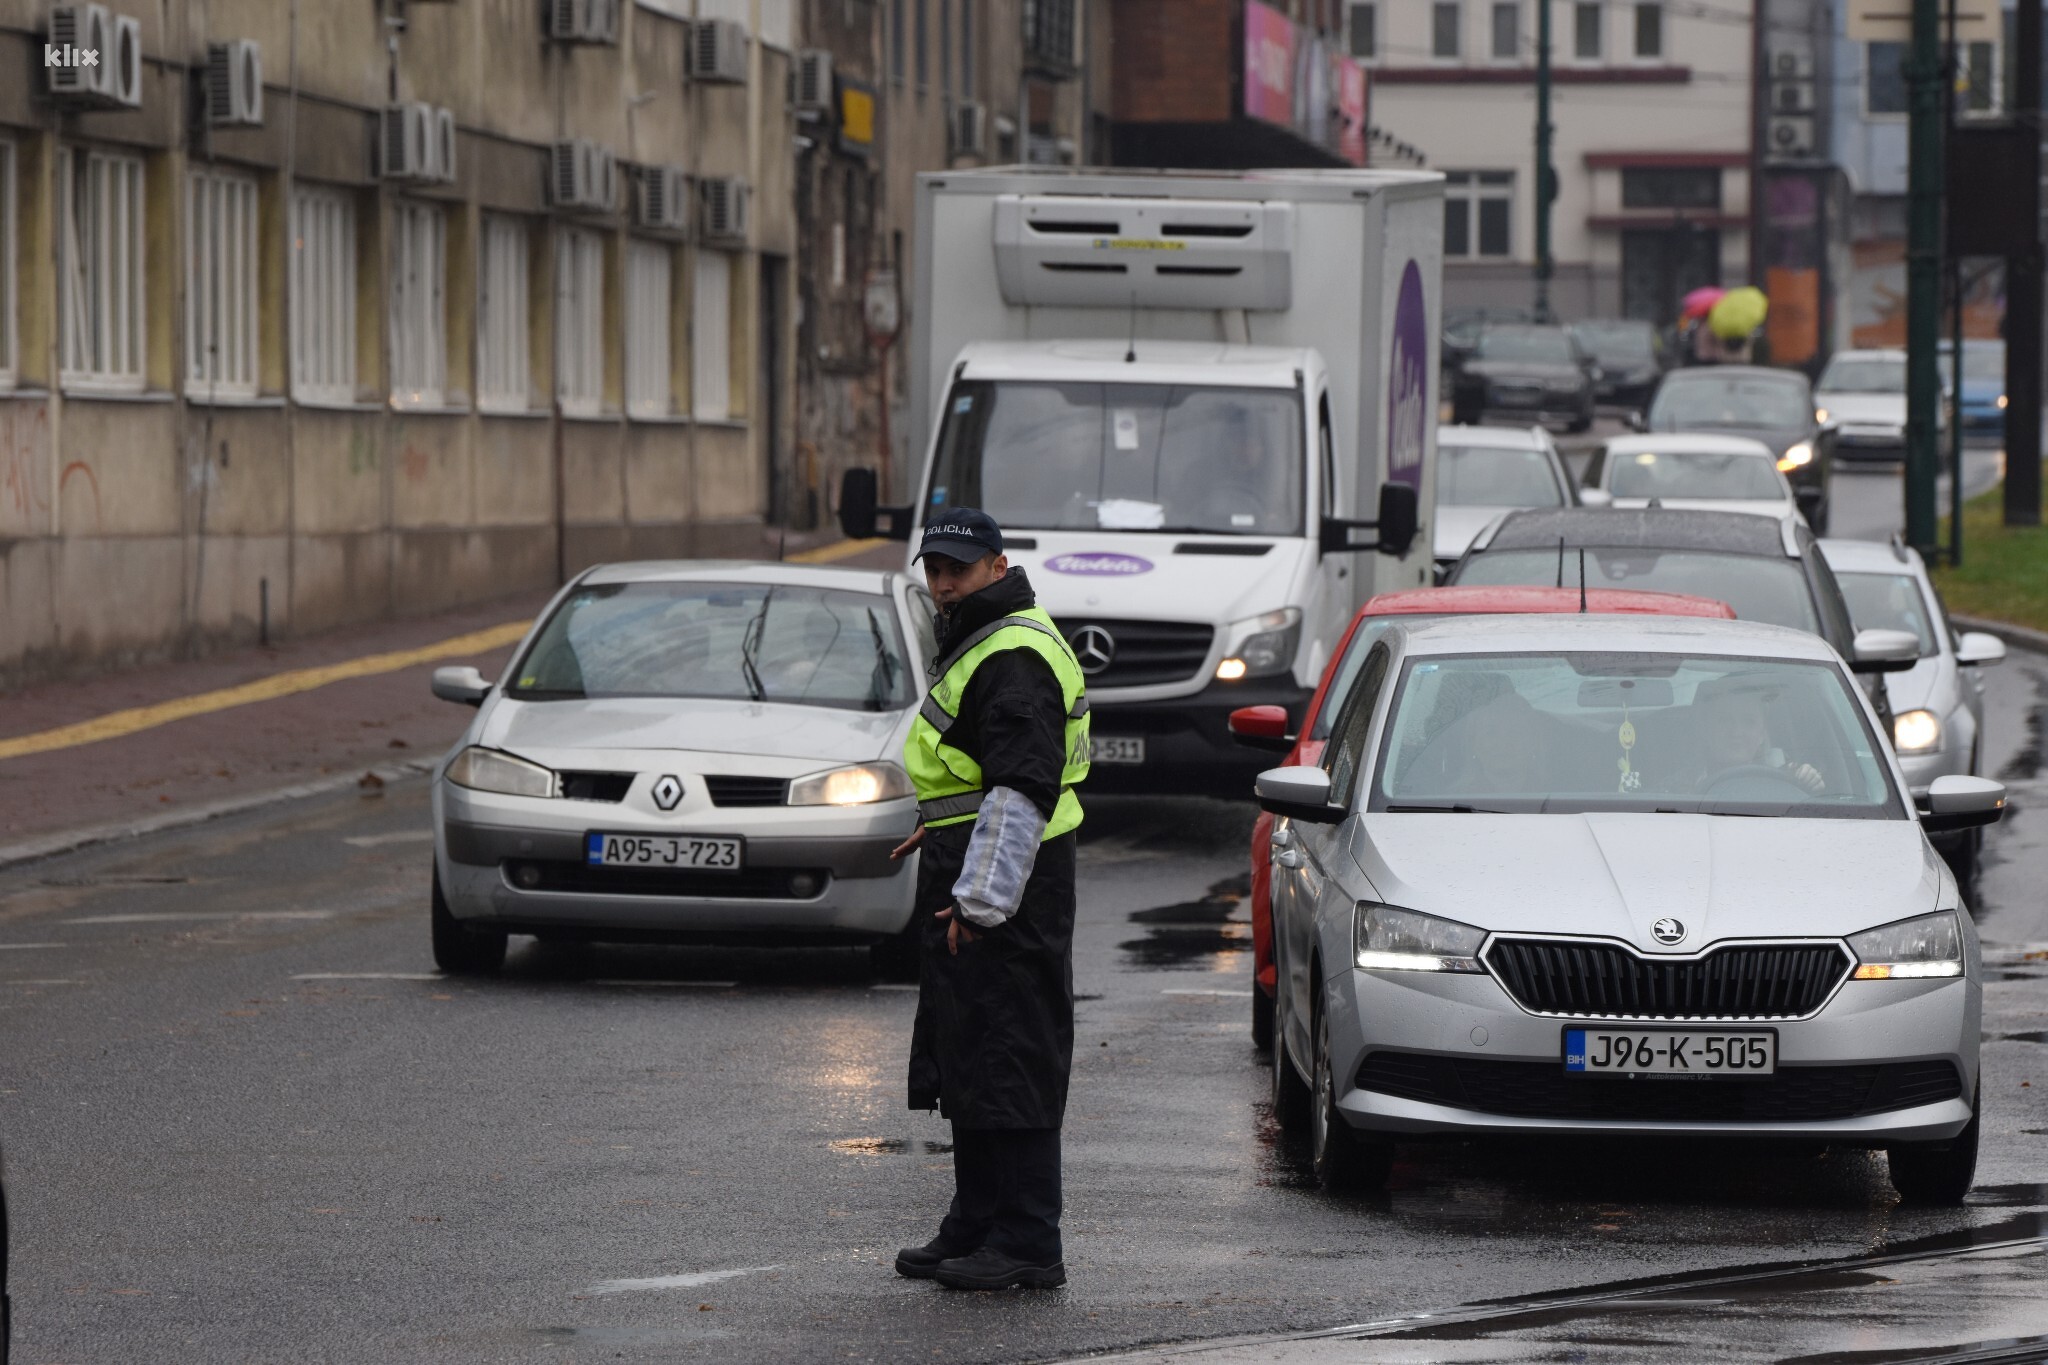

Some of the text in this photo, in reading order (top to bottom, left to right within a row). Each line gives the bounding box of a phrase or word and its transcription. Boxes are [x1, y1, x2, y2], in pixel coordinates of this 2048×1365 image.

[926, 524, 974, 537] POLICIJA
[605, 838, 736, 867] A95-J-723
[1567, 1036, 1768, 1068] BIH J96-K-505
